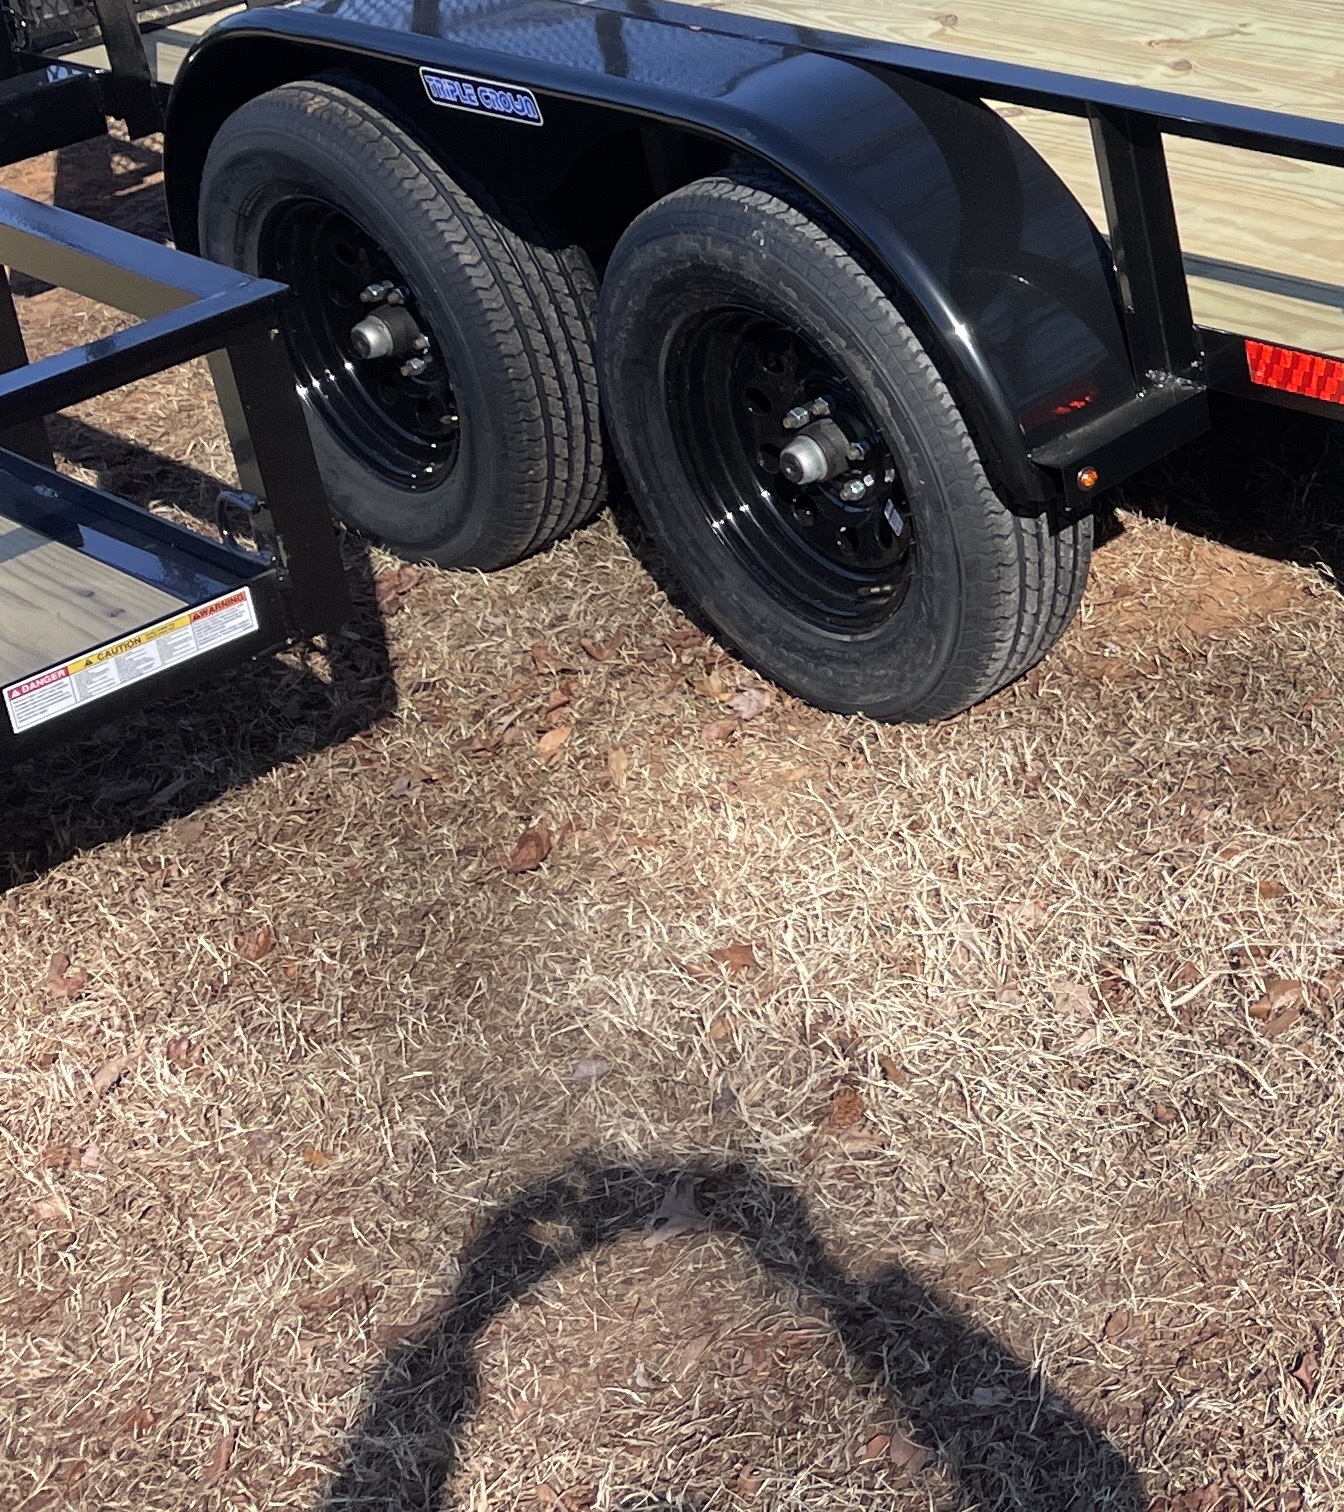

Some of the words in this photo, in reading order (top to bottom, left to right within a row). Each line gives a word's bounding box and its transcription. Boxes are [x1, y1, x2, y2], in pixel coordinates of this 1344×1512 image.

[424, 74, 480, 106] TRIPLE
[477, 86, 539, 119] CROWN
[199, 593, 244, 617] WARNING
[96, 637, 142, 661] CAUTION
[20, 669, 67, 694] DANGER
